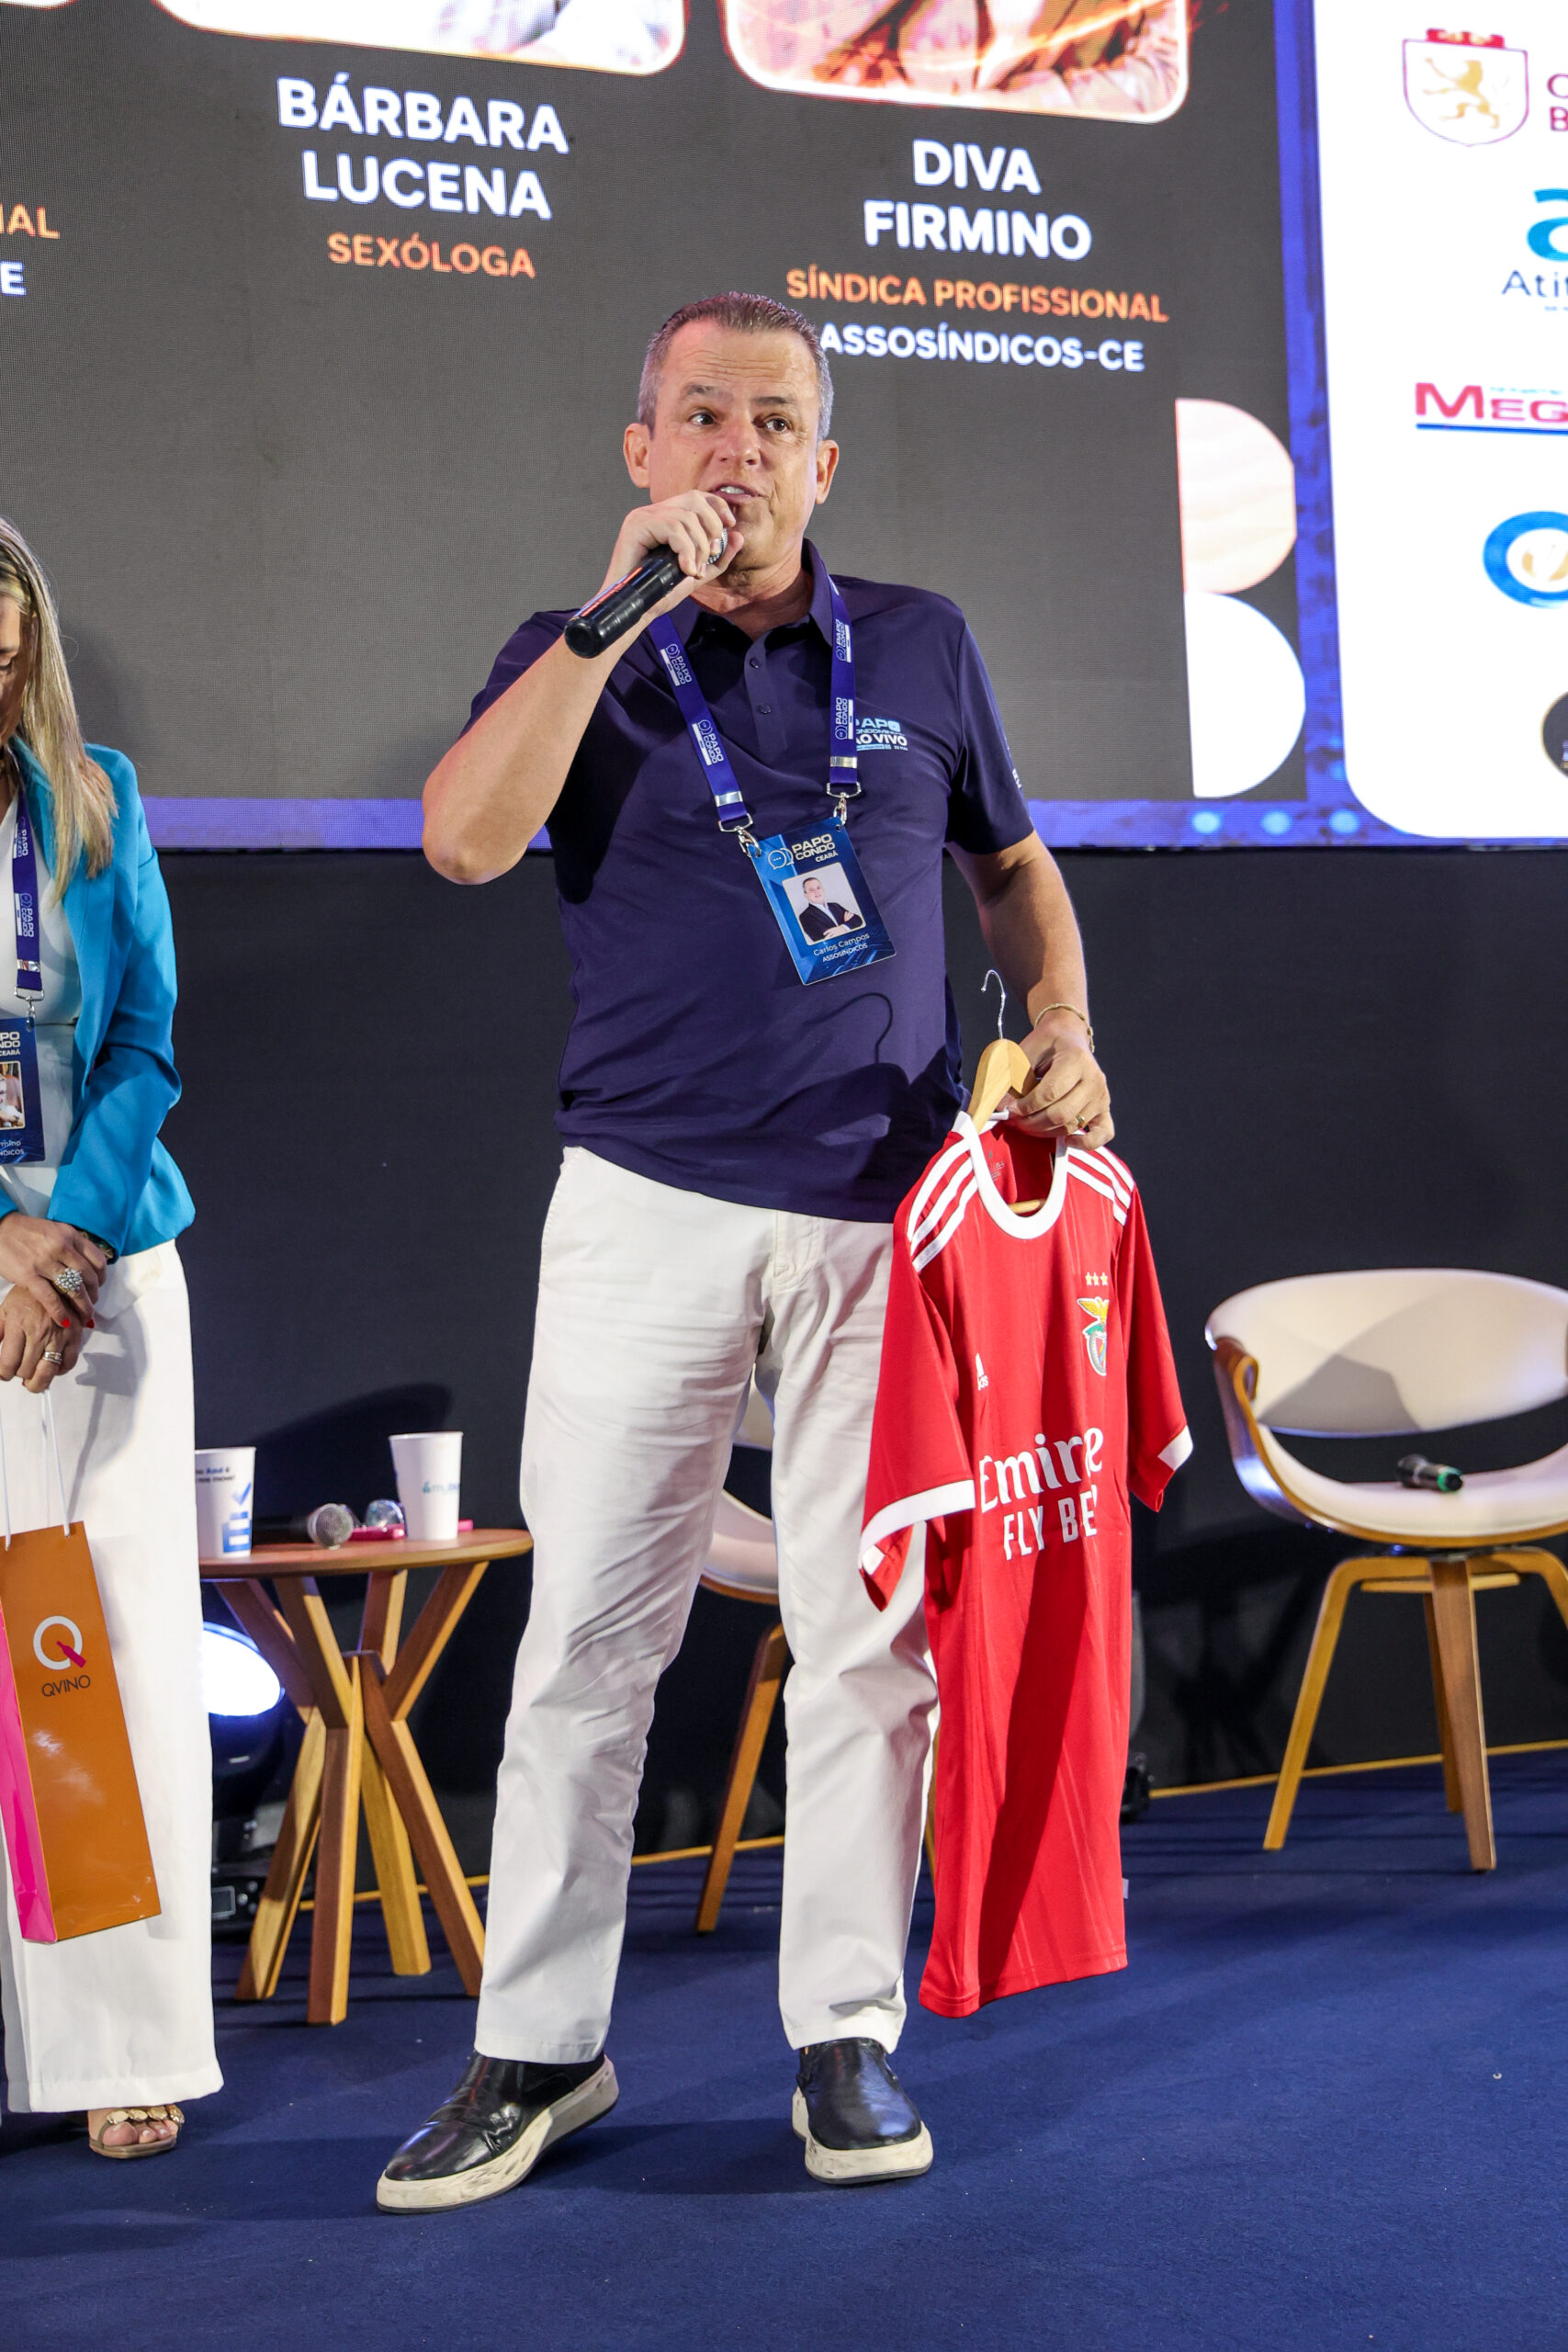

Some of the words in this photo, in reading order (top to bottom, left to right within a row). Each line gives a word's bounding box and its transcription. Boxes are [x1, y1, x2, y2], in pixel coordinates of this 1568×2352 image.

[277, 73, 569, 153] BÁRBARA
[913, 138, 1043, 195] DIVA
[302, 150, 552, 220] LUCENA
[863, 199, 1093, 262] FIRMINO
[328, 232, 536, 278] SEXÓLOGA
[786, 264, 927, 306] SÍNDICA
[933, 279, 1169, 323] PROFISSIONAL
[820, 322, 1145, 372] ASSOSÍNDICOS-CE
[671, 659, 686, 684] CONDO
[676, 656, 692, 683] PAPO
[704, 735, 718, 763] CONDO
[707, 733, 724, 762] PAPO
[873, 733, 908, 746] VIVO
[792, 833, 833, 854] PAPO
[795, 842, 836, 861] CONDO
[815, 850, 839, 863] CEARÁ
[813, 944, 838, 956] Carlos
[838, 933, 870, 948] Campos
[1003, 1506, 1045, 1560] FLY
[41, 1675, 91, 1697] QVINO
